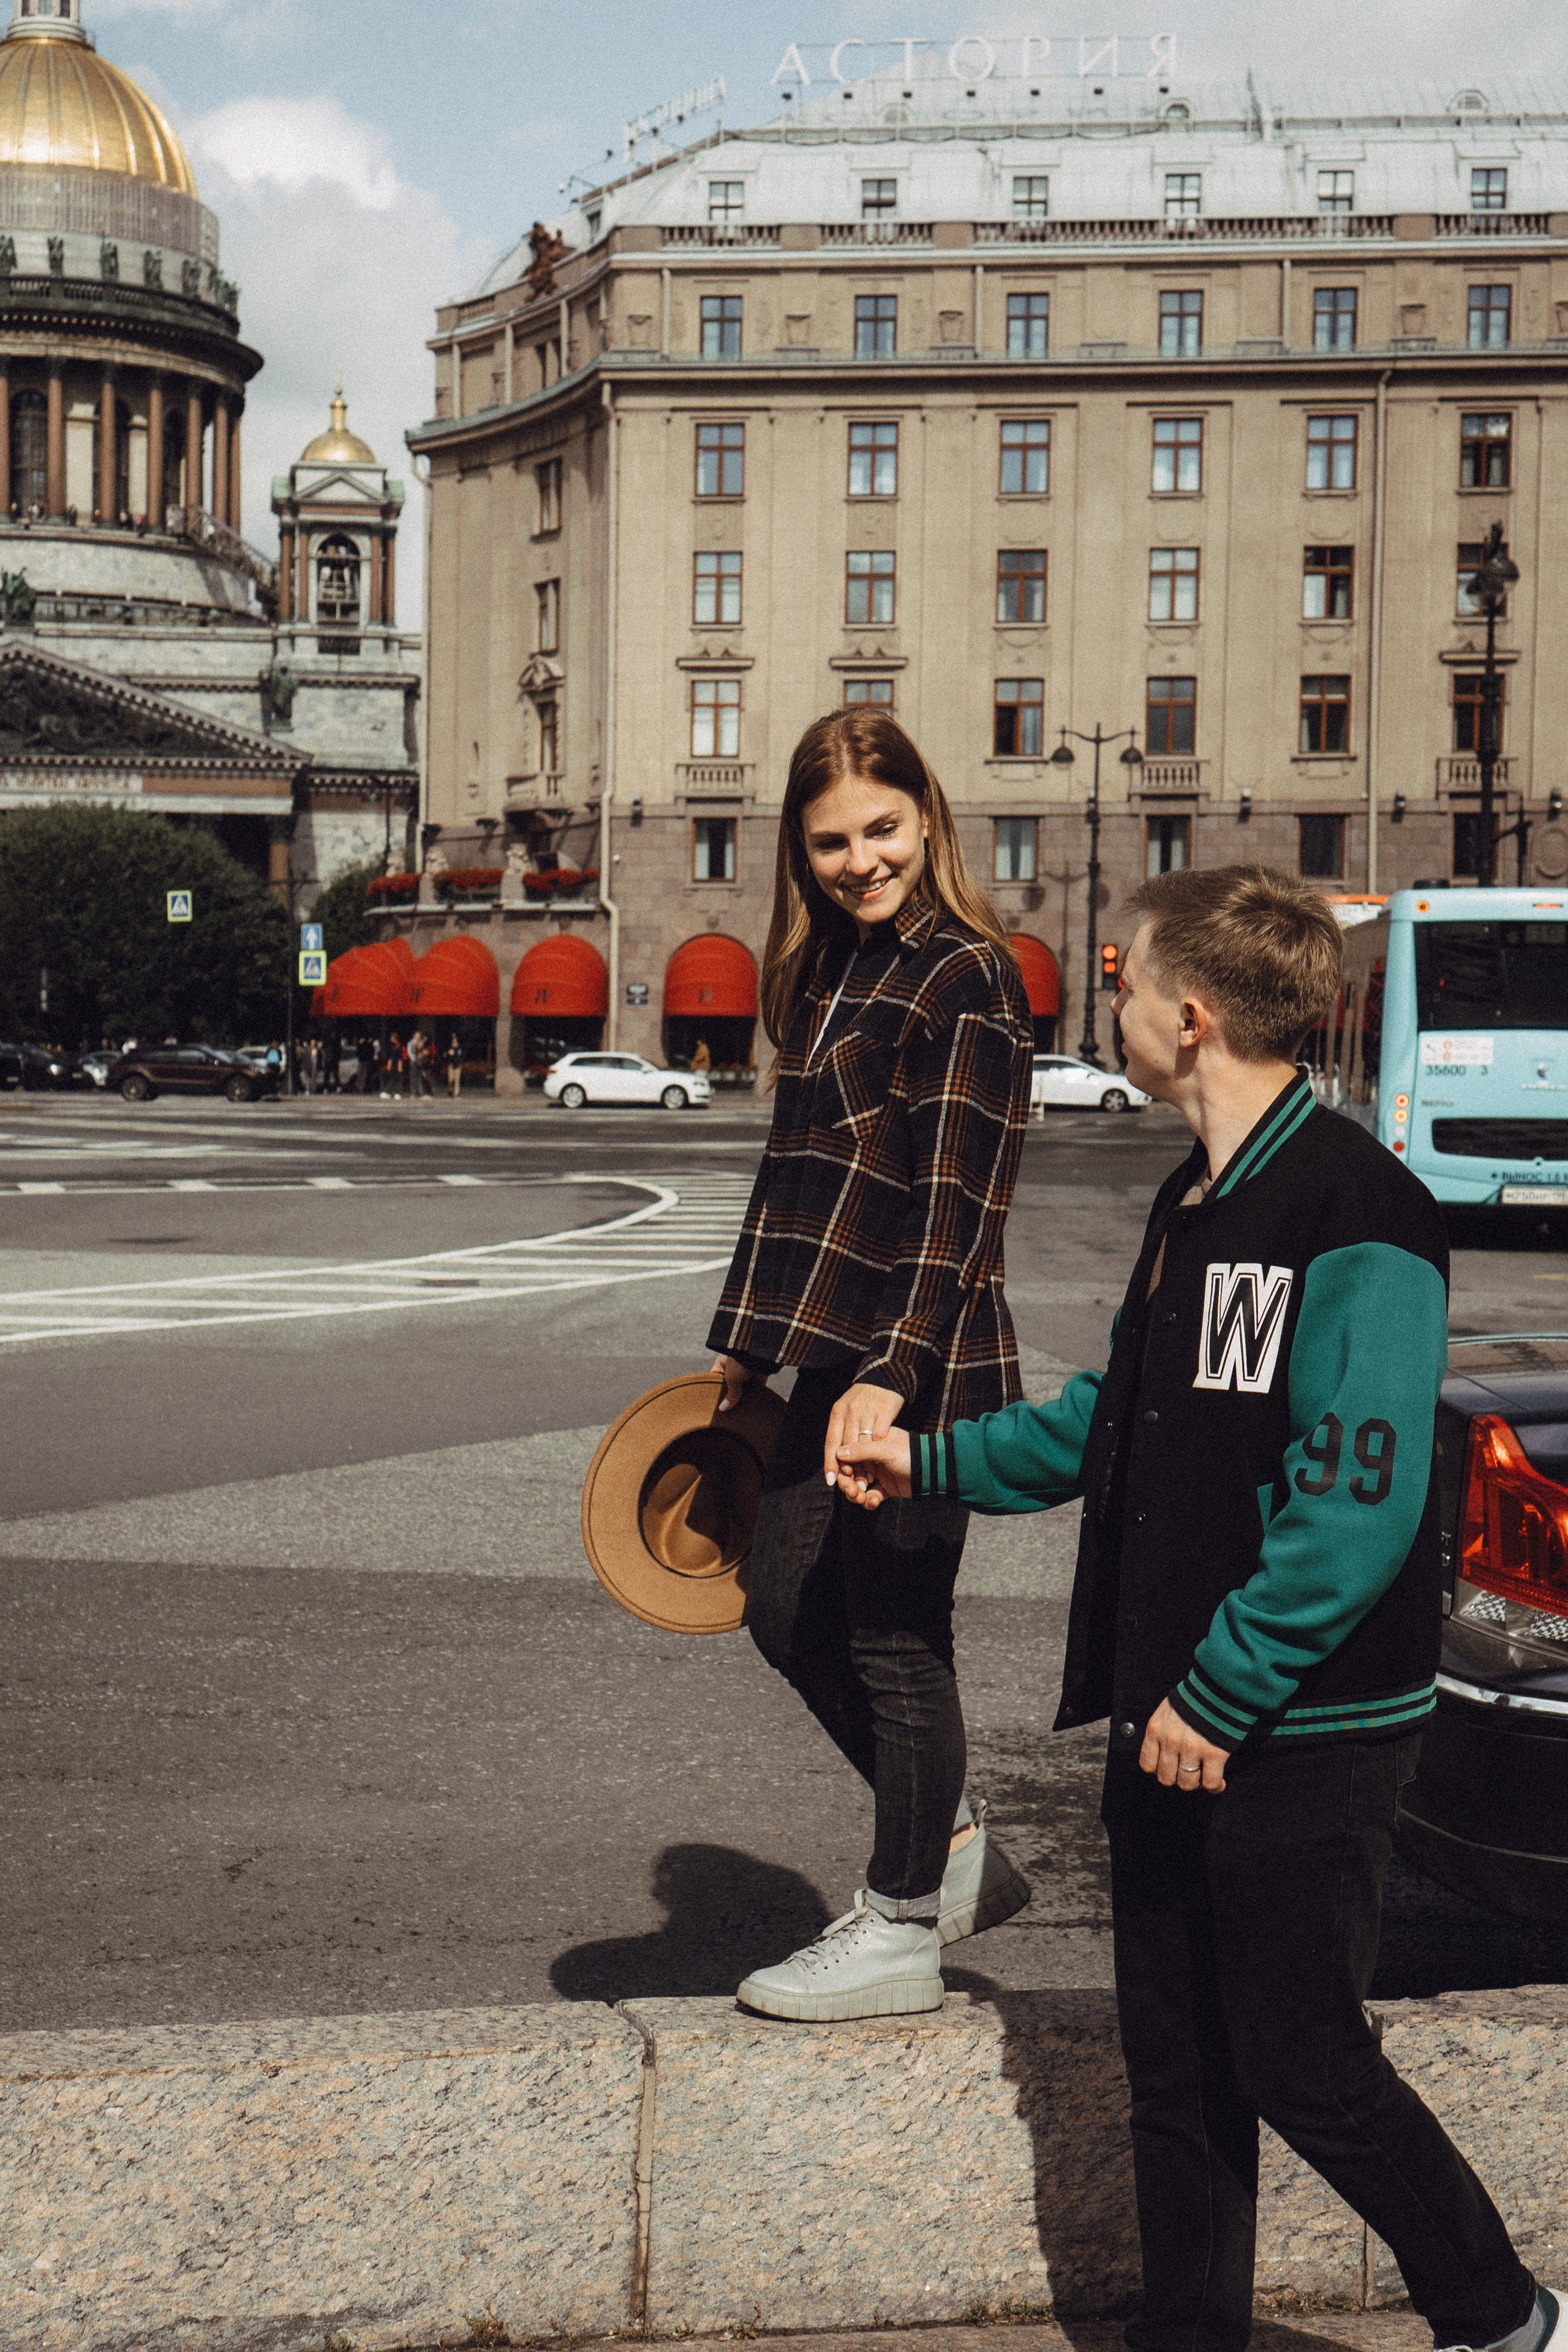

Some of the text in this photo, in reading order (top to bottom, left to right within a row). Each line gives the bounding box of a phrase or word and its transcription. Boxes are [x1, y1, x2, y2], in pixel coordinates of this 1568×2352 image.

[770, 32, 1177, 85] АСТОРИЯ
[1193, 1263, 1293, 1393] W
[1294, 1412, 1397, 1506] 99
